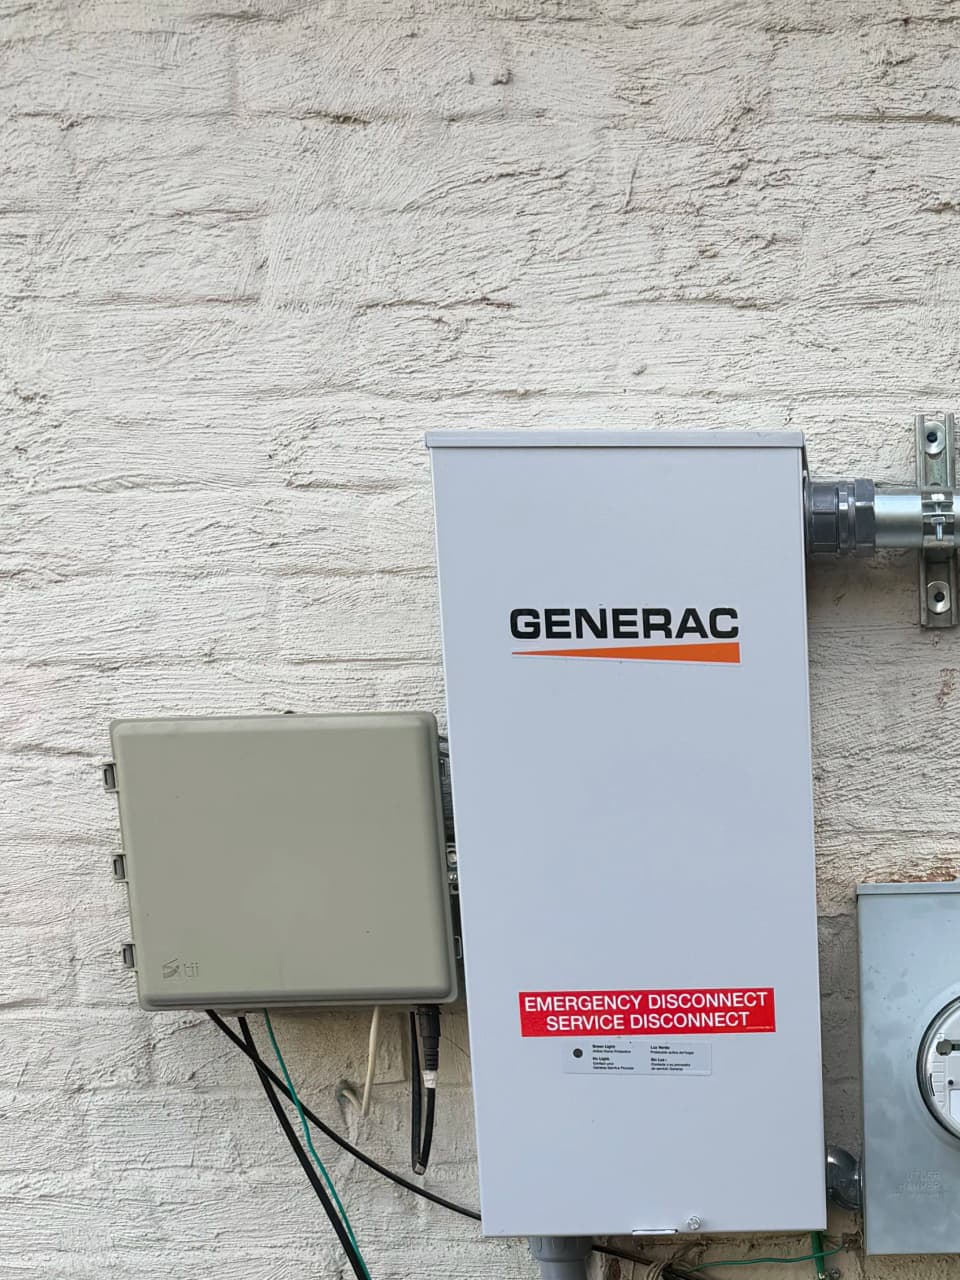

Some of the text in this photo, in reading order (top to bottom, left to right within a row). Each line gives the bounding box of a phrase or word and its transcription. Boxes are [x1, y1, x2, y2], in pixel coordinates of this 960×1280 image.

[510, 607, 739, 639] GENERAC
[524, 992, 768, 1012] EMERGENCY DISCONNECT
[546, 1011, 749, 1031] SERVICE DISCONNECT
